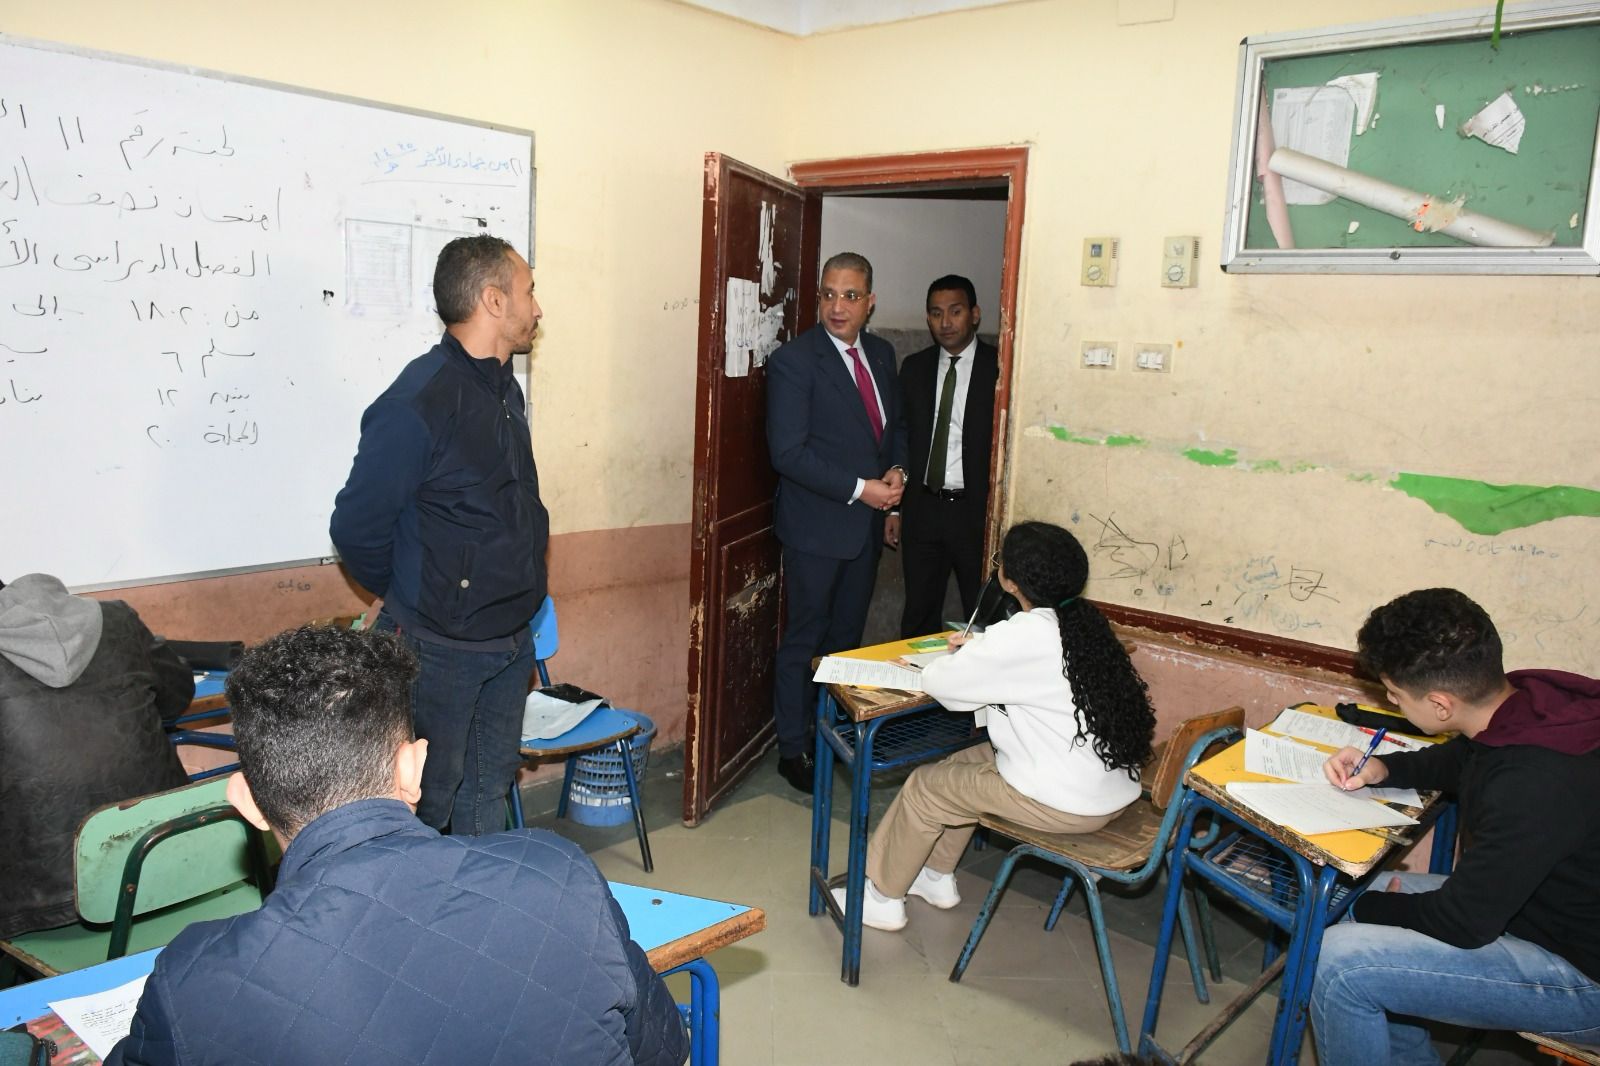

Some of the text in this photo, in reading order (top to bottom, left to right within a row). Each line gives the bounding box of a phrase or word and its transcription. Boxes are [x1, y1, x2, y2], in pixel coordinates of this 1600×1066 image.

[119, 108, 165, 171] رقم
[43, 172, 159, 219] نصف
[174, 185, 283, 232] امتحان
[185, 240, 272, 278] الفصل
